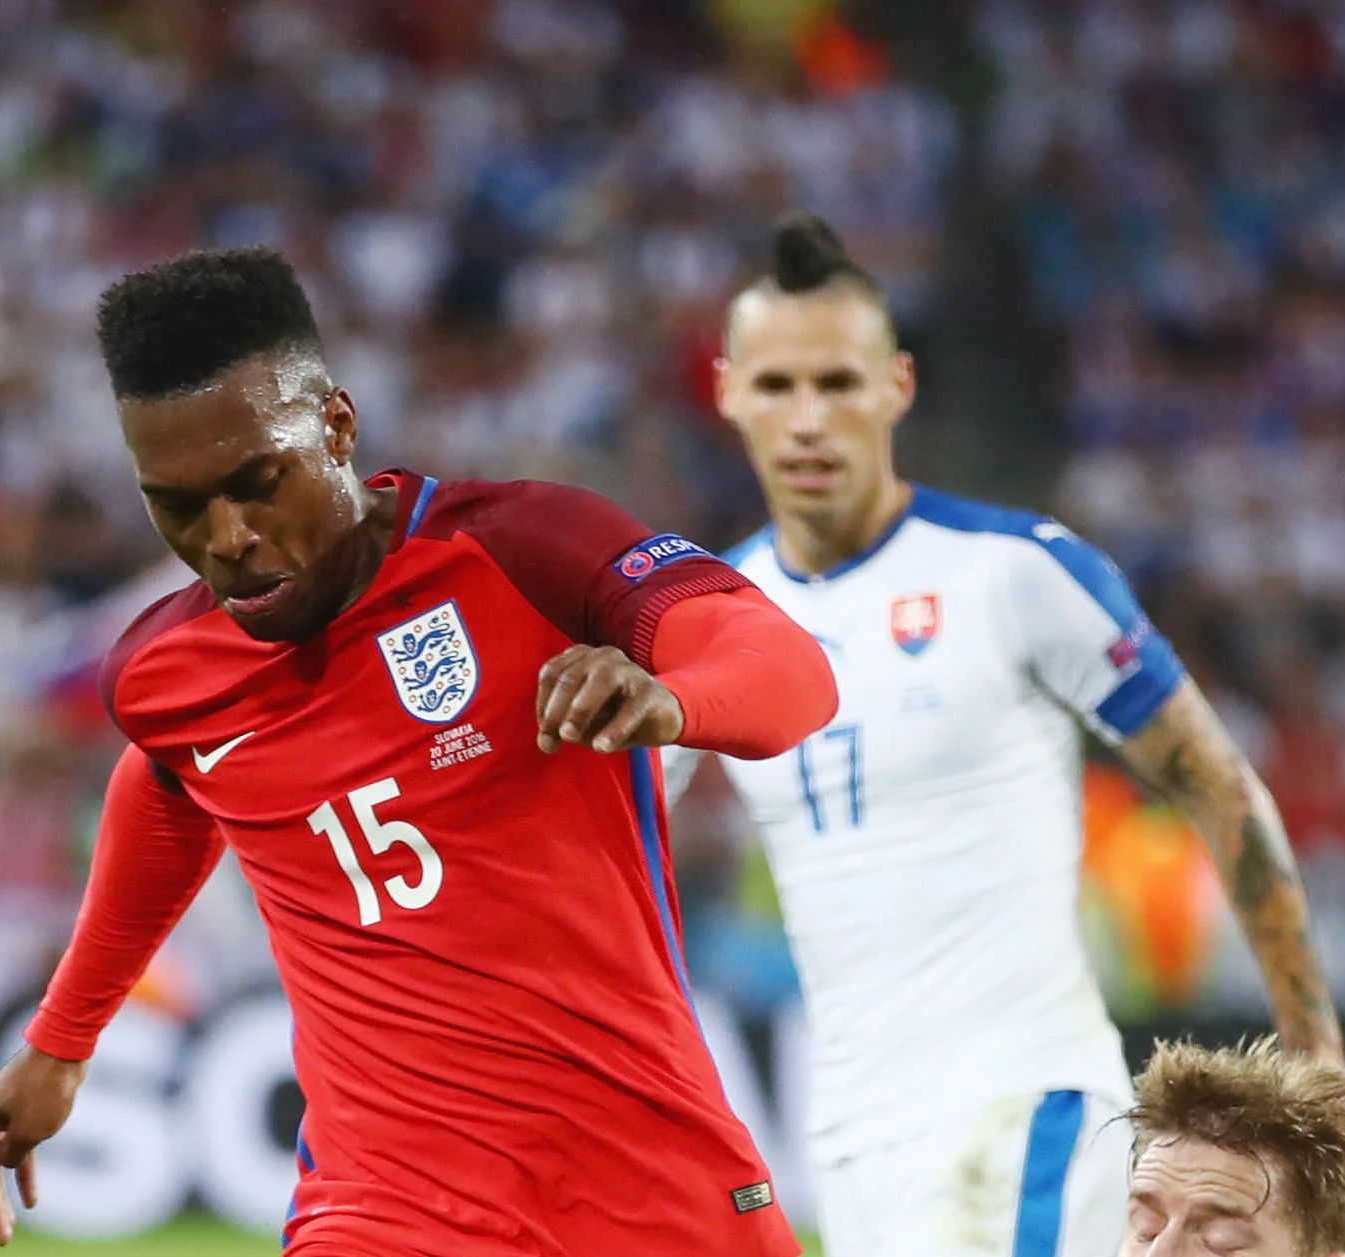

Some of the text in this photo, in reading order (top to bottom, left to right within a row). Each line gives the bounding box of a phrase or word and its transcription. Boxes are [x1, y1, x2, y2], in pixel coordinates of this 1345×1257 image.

[434, 723, 475, 744] SLOVAKIA
[444, 738, 465, 755] JUNE
[797, 725, 864, 832] 17
[306, 777, 444, 926] 15
